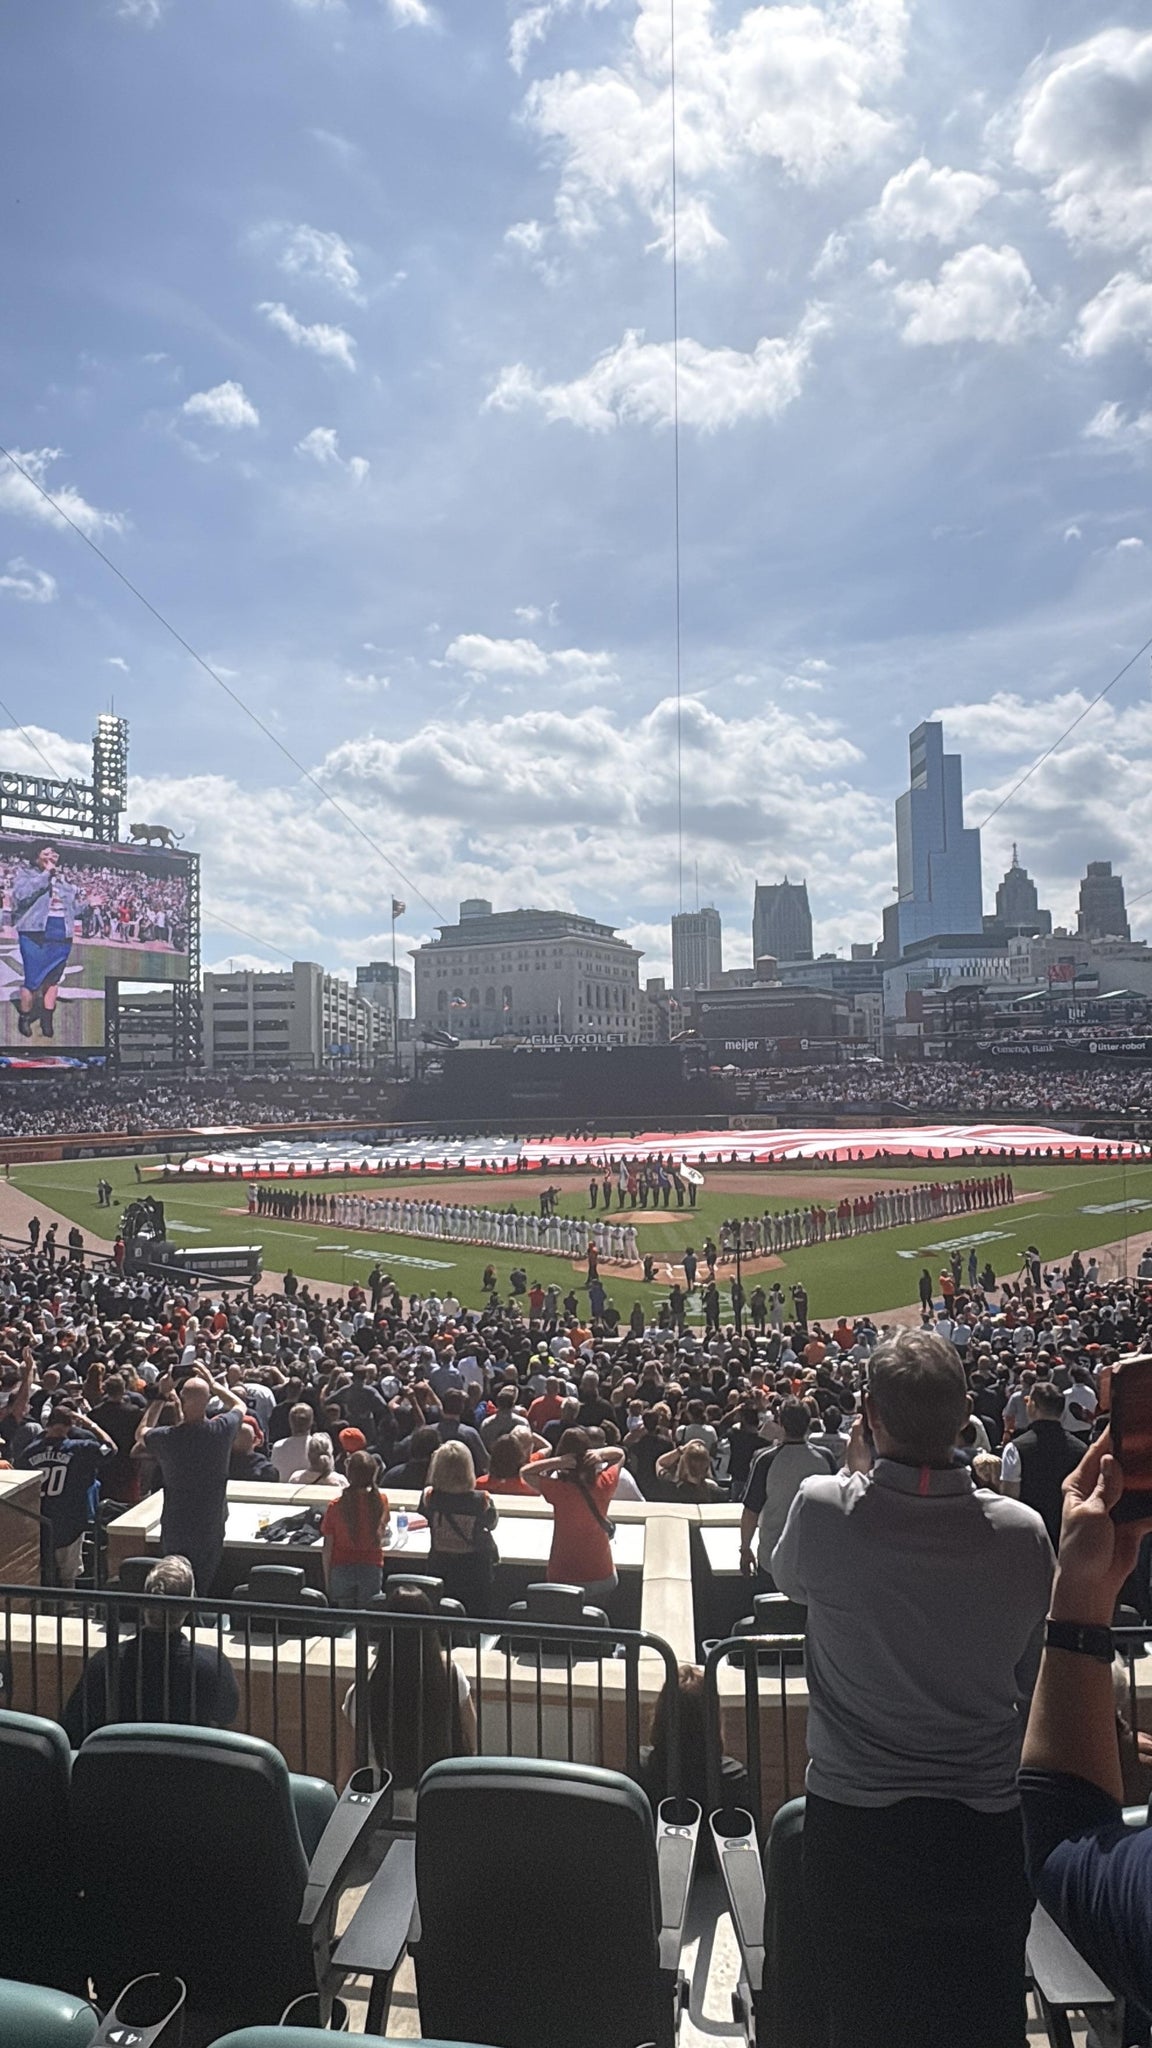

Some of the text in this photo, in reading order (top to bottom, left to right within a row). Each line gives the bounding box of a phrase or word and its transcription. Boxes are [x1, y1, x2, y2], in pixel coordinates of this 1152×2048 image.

[532, 1033, 626, 1044] CHEVROLET
[725, 1039, 759, 1052] meijer
[39, 1466, 68, 1497] 20
